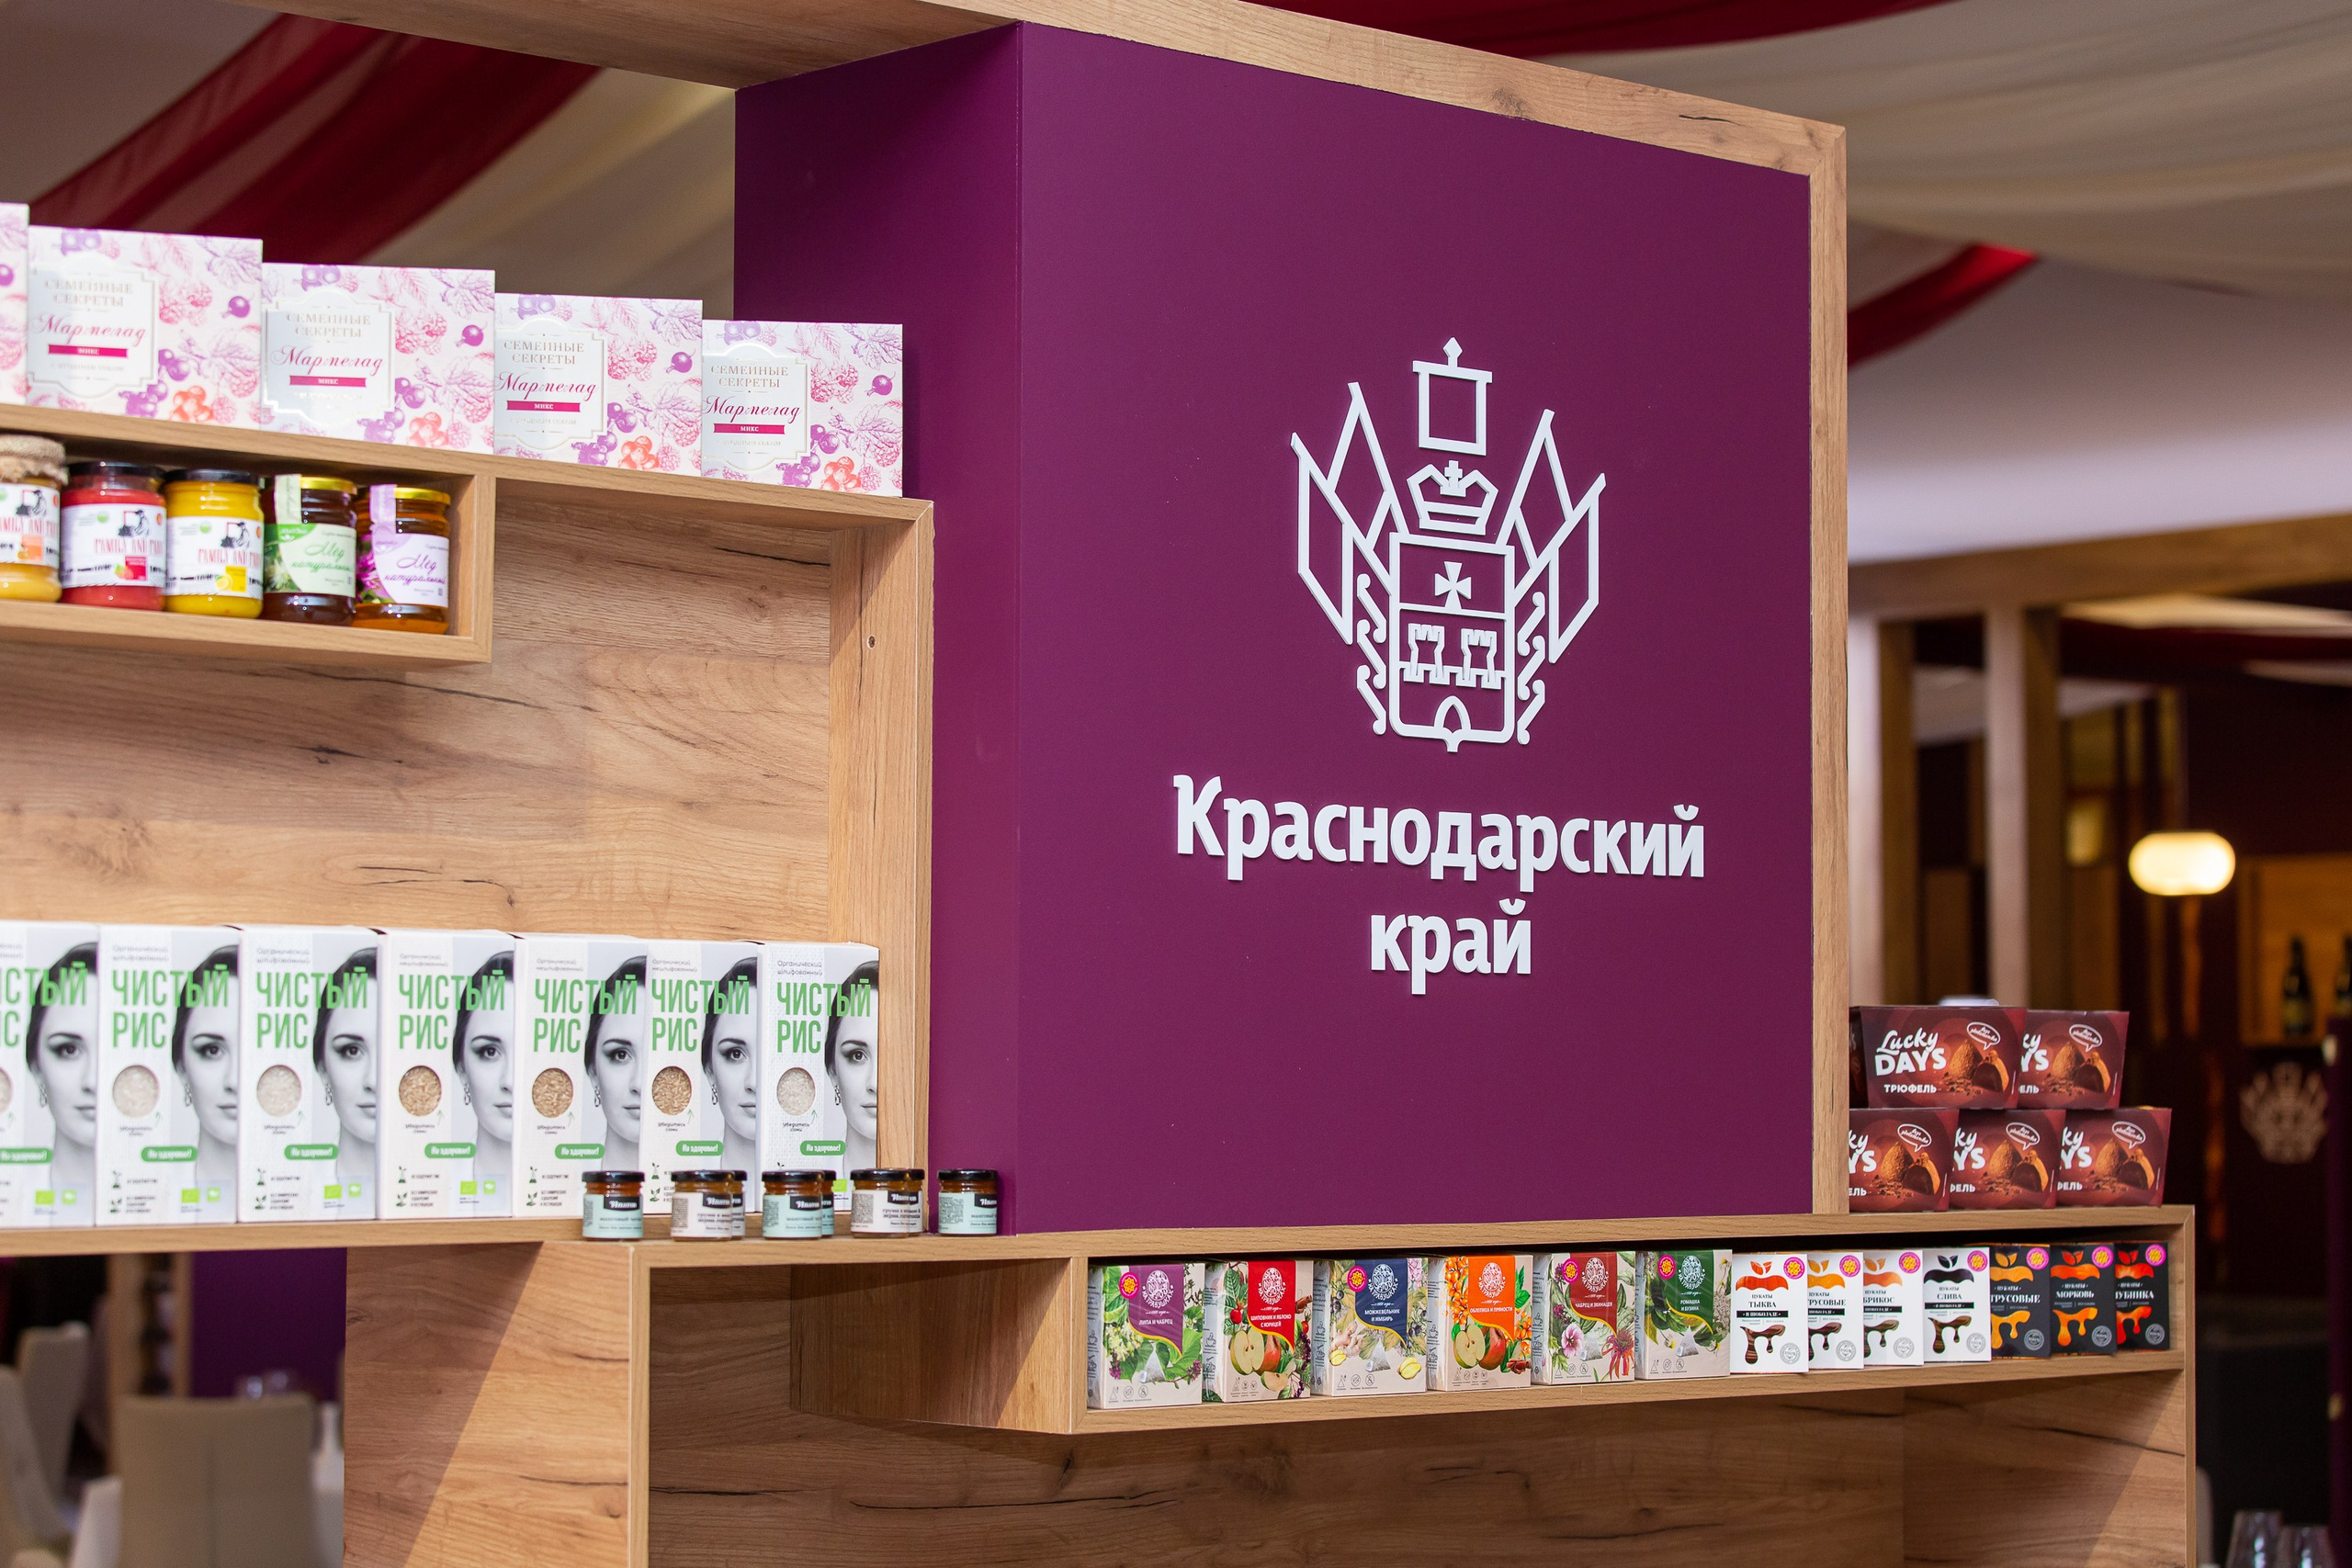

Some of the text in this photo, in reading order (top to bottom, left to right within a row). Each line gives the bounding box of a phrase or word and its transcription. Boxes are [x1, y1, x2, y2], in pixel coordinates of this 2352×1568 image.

[512, 354, 575, 365] СЕКРЕТЫ
[718, 378, 780, 388] СЕКРЕТЫ
[1173, 773, 1704, 892] Краснодарский
[1371, 897, 1532, 995] край
[776, 960, 822, 968] Органический
[0, 961, 88, 1007] СТЫЙ
[111, 964, 230, 1008] ЧИСТЫЙ
[255, 966, 368, 1010] ЧИСТЫЙ
[398, 969, 505, 1011] ЧИСТЫЙ
[535, 974, 638, 1015] ЧИСТЫЙ
[651, 975, 750, 1015] ЧИСТЫЙ
[776, 978, 871, 1018] ЧИСТЫЙ
[112, 1011, 166, 1049] РИС
[256, 1013, 309, 1049] РИС
[398, 1014, 448, 1050] РИС
[533, 1018, 582, 1053] РИС
[652, 1018, 698, 1053] РИС
[777, 1020, 821, 1054] РИС
[1876, 1027, 1939, 1056] Lucky
[1874, 1047, 1947, 1077] DAYS
[1883, 1083, 1938, 1094] ТРЮФЕЛЬ
[1951, 1147, 1986, 1172] YS
[2059, 1145, 2093, 1170] YS
[2056, 1290, 2095, 1299] МОРКОВЬ
